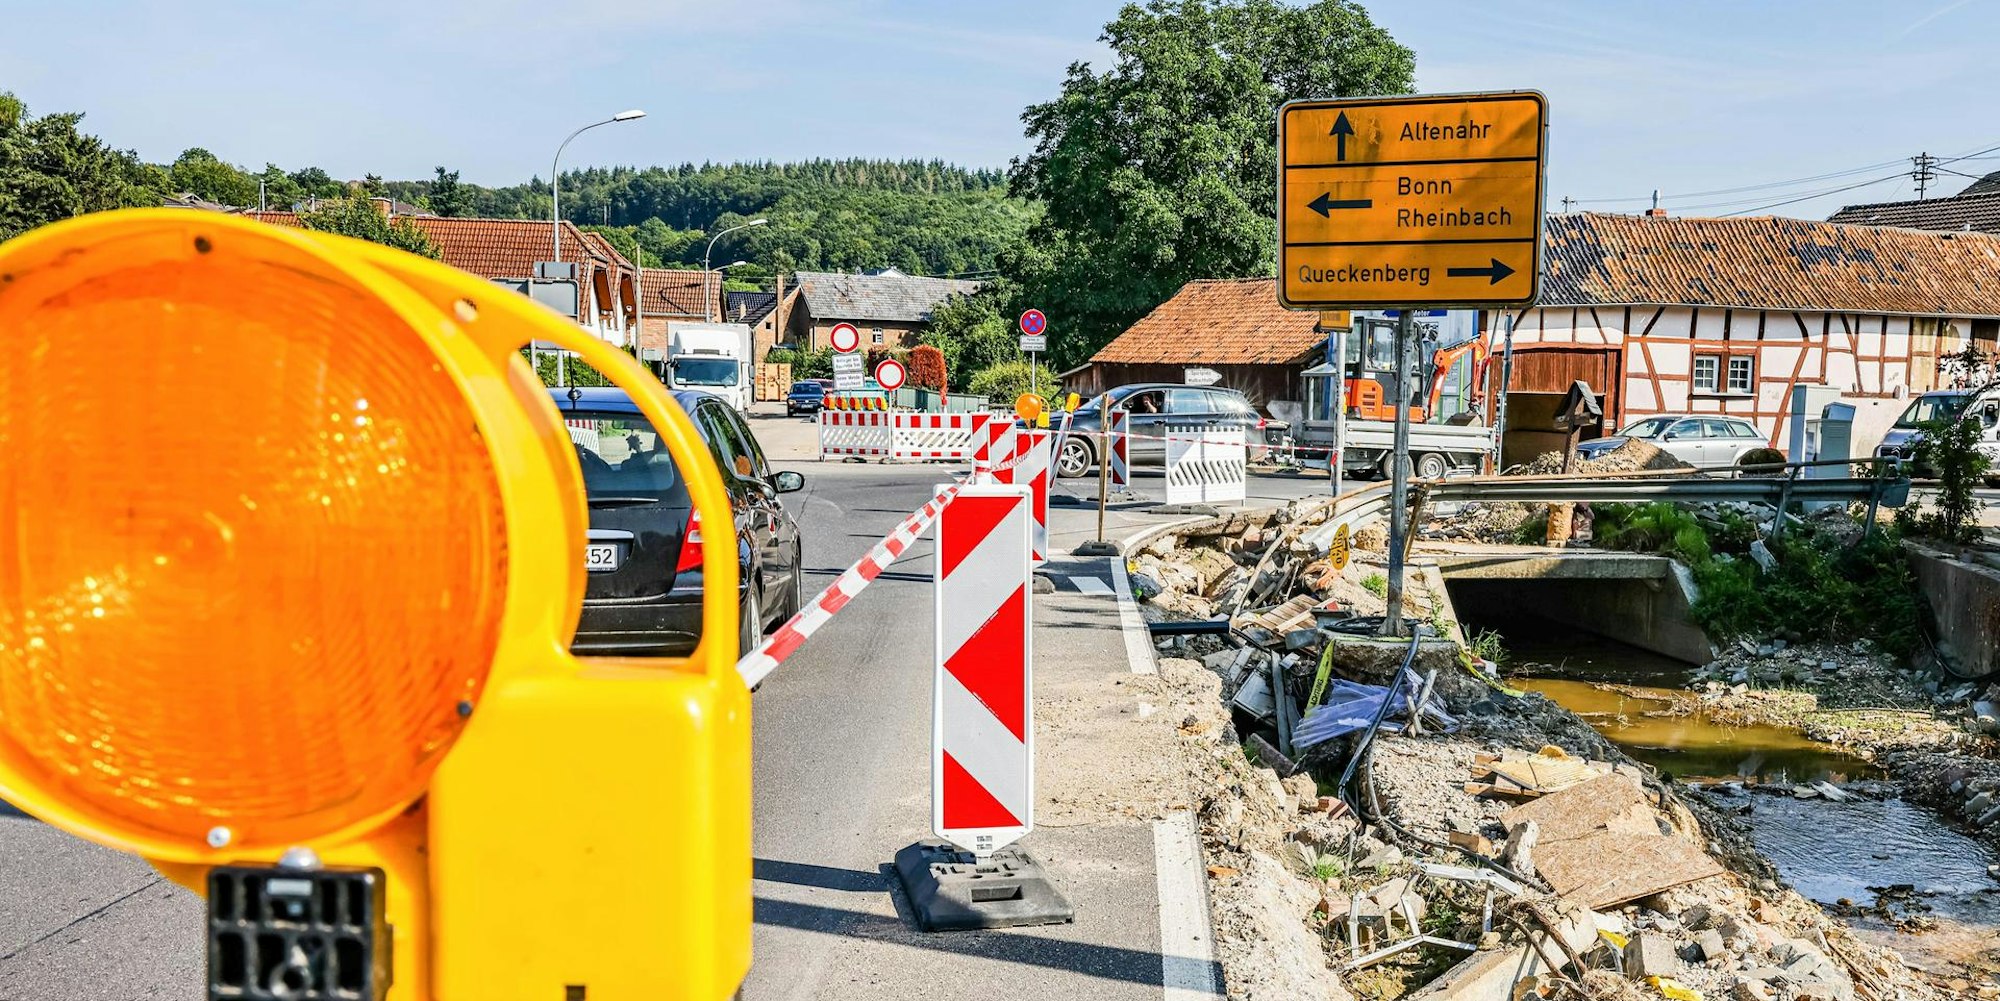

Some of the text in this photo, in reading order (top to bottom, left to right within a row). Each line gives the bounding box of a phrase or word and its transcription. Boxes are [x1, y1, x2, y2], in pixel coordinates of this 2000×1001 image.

[1400, 120, 1491, 141] Altenahr
[1398, 177, 1452, 196] Bonn
[1397, 206, 1512, 228] Rheinbach
[1299, 264, 1430, 286] Queckenberg
